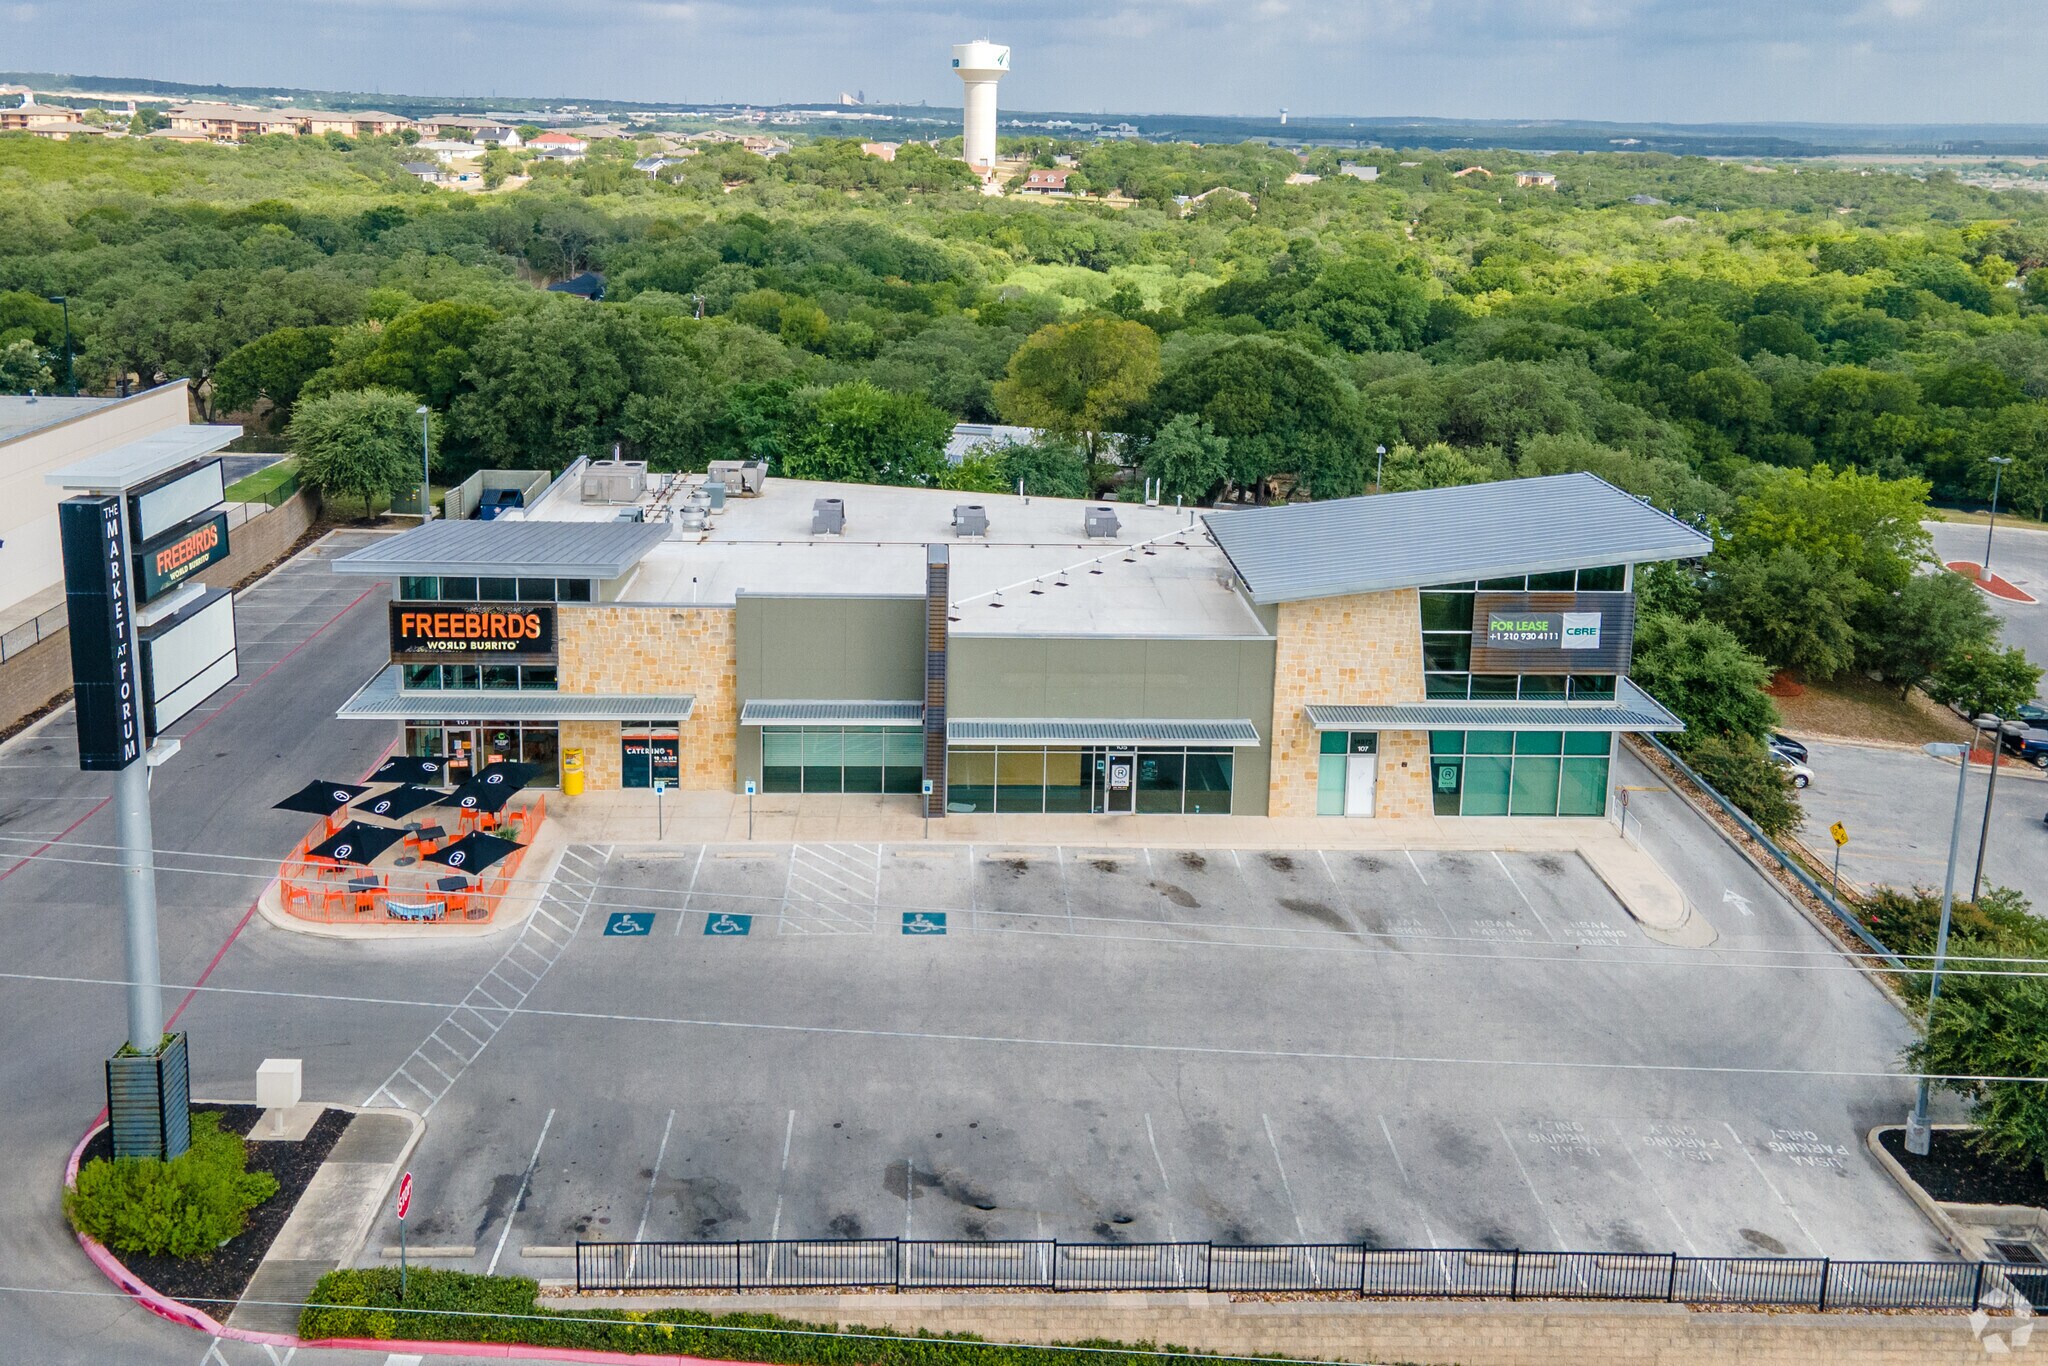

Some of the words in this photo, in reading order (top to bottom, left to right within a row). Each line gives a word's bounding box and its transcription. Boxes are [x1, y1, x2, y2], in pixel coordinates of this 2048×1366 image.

[103, 503, 118, 519] THE
[106, 519, 125, 639] MARKET
[401, 613, 541, 639] FREEB!RDS
[1491, 621, 1514, 631] FOR
[1516, 621, 1549, 631] LEASE
[1566, 627, 1597, 636] CBRE
[1503, 632, 1520, 640] 210
[1521, 632, 1537, 640] 930
[1537, 632, 1559, 640] 4111
[117, 642, 127, 658] AT
[120, 661, 136, 761] FORUM
[1768, 1141, 1850, 1156] PARKING
[1788, 1155, 1843, 1168] USAA
[399, 1179, 411, 1213] STOP
